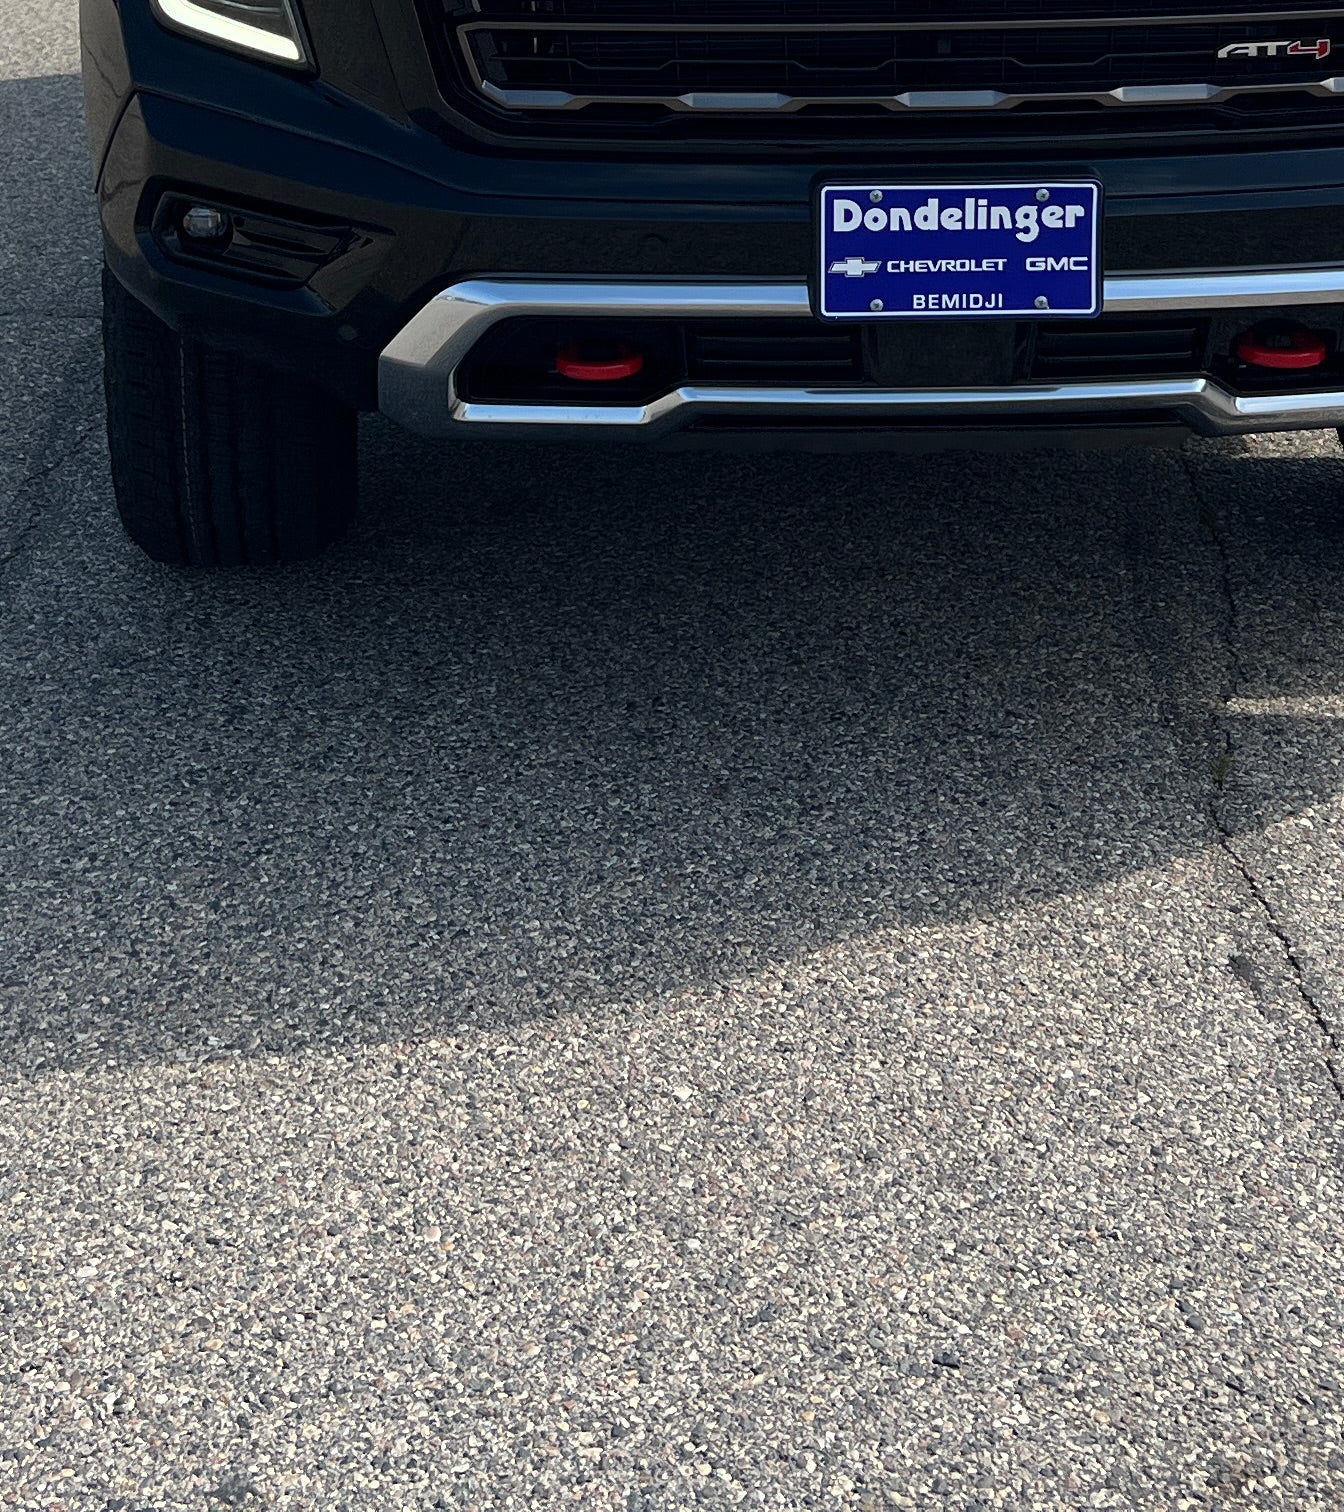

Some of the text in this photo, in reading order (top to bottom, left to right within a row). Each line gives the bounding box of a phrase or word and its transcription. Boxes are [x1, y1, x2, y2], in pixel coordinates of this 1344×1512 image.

[1217, 38, 1331, 60] AT4
[832, 197, 1086, 243] Dondelinger
[886, 256, 1089, 273] CHEVROLET GMC
[912, 293, 1004, 309] BEMIDJI
